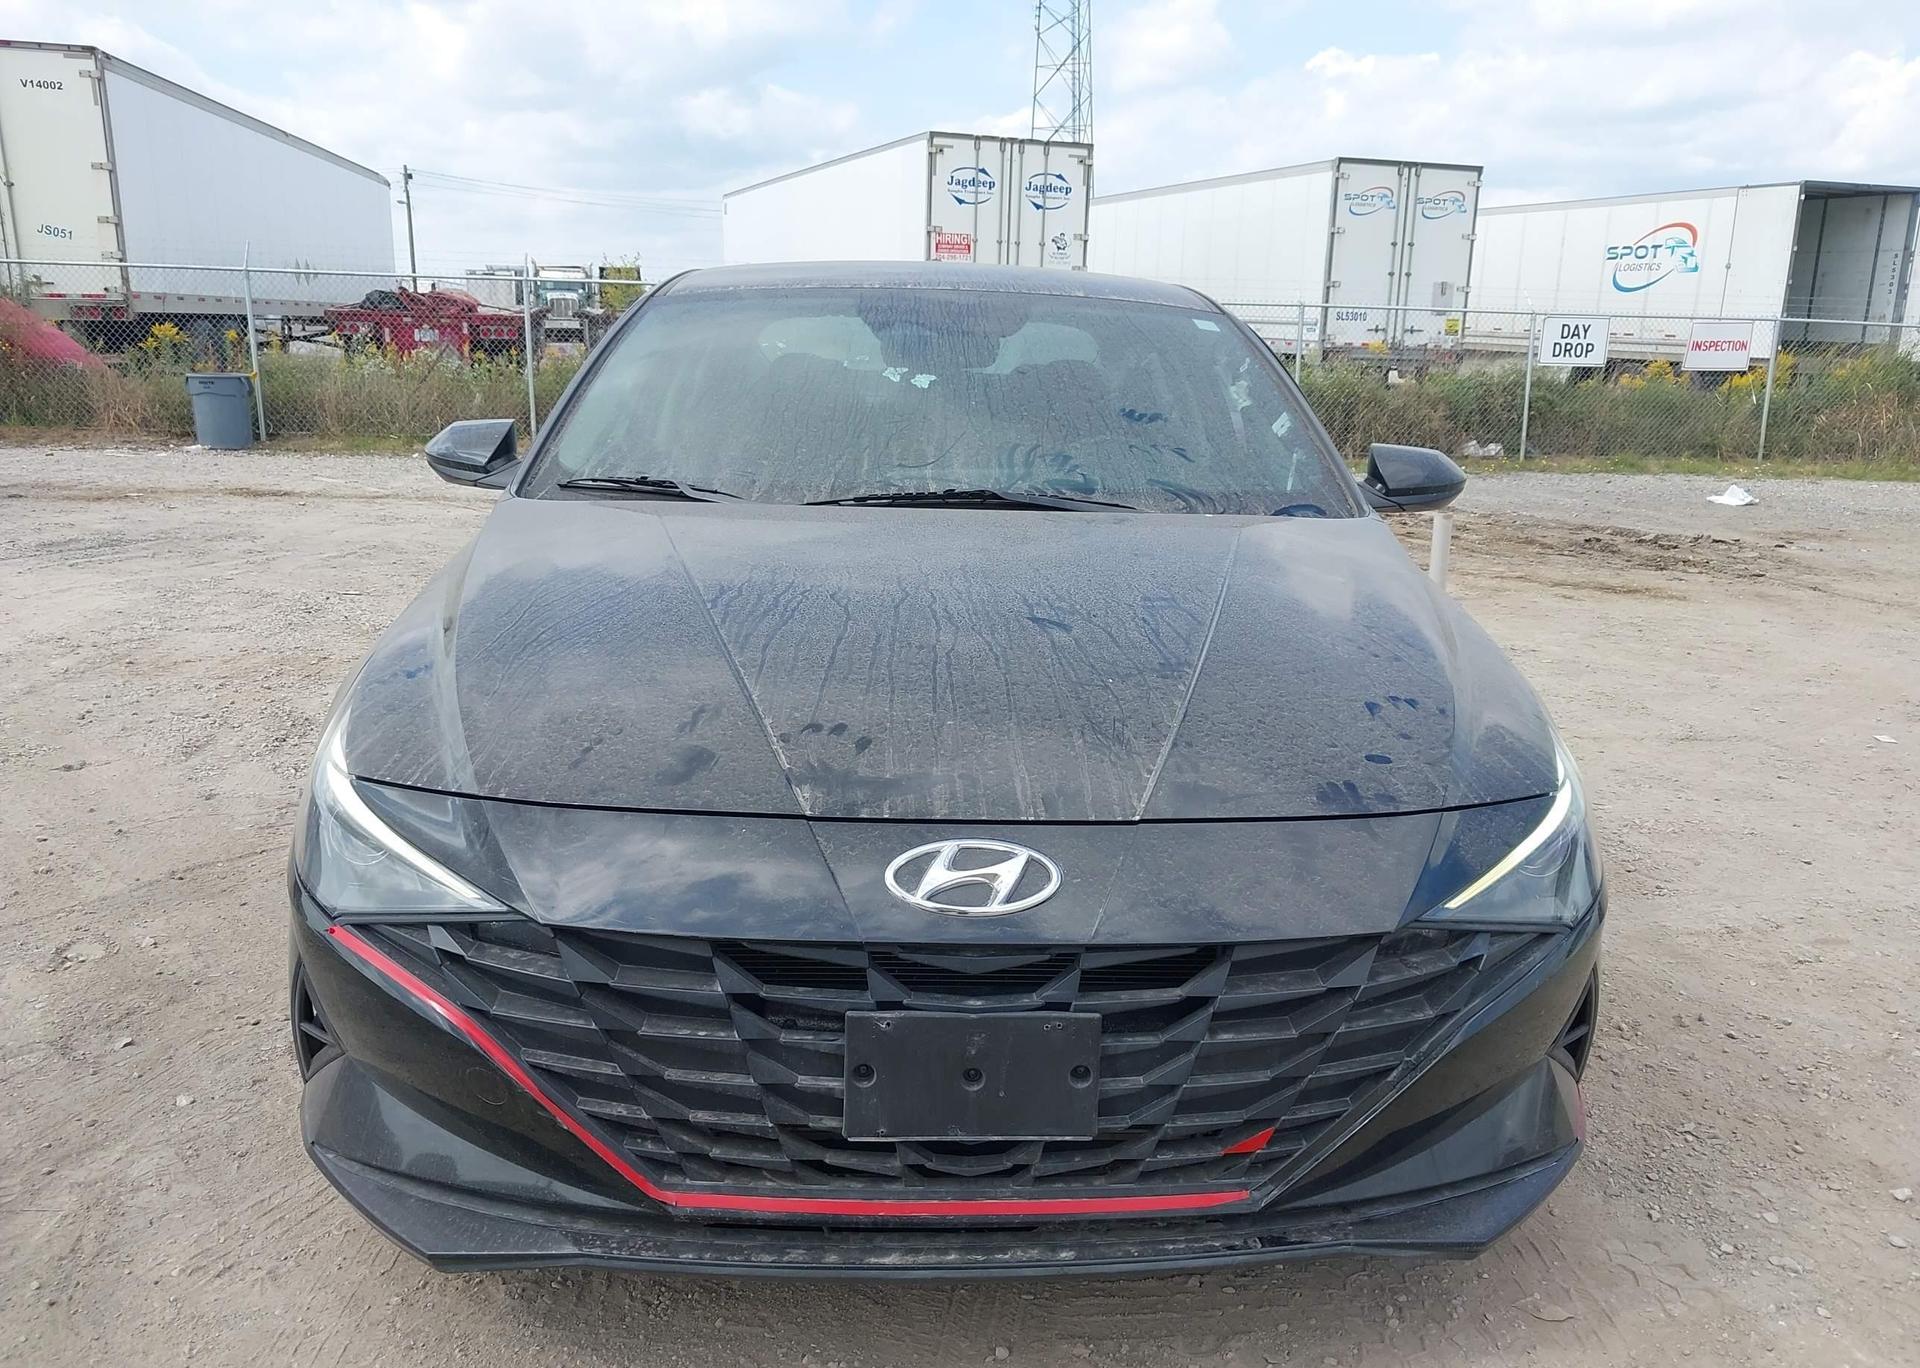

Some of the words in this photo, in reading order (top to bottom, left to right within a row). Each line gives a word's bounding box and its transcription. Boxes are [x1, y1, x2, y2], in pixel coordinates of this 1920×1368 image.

[19, 78, 64, 91] V14002
[947, 175, 996, 190] Jagdeep
[1025, 181, 1072, 196] Jagdeep
[1344, 193, 1377, 202] SPOT
[1417, 197, 1448, 206] SPOT
[37, 224, 73, 240] JS051
[936, 233, 971, 245] HIRING!
[1606, 245, 1663, 260] SPOT
[1619, 263, 1662, 271] LOGISTICS
[1336, 311, 1368, 321] SL53010
[1561, 324, 1591, 339] DAY
[1552, 342, 1595, 358] DROP
[1691, 340, 1748, 352] INSPECTION
